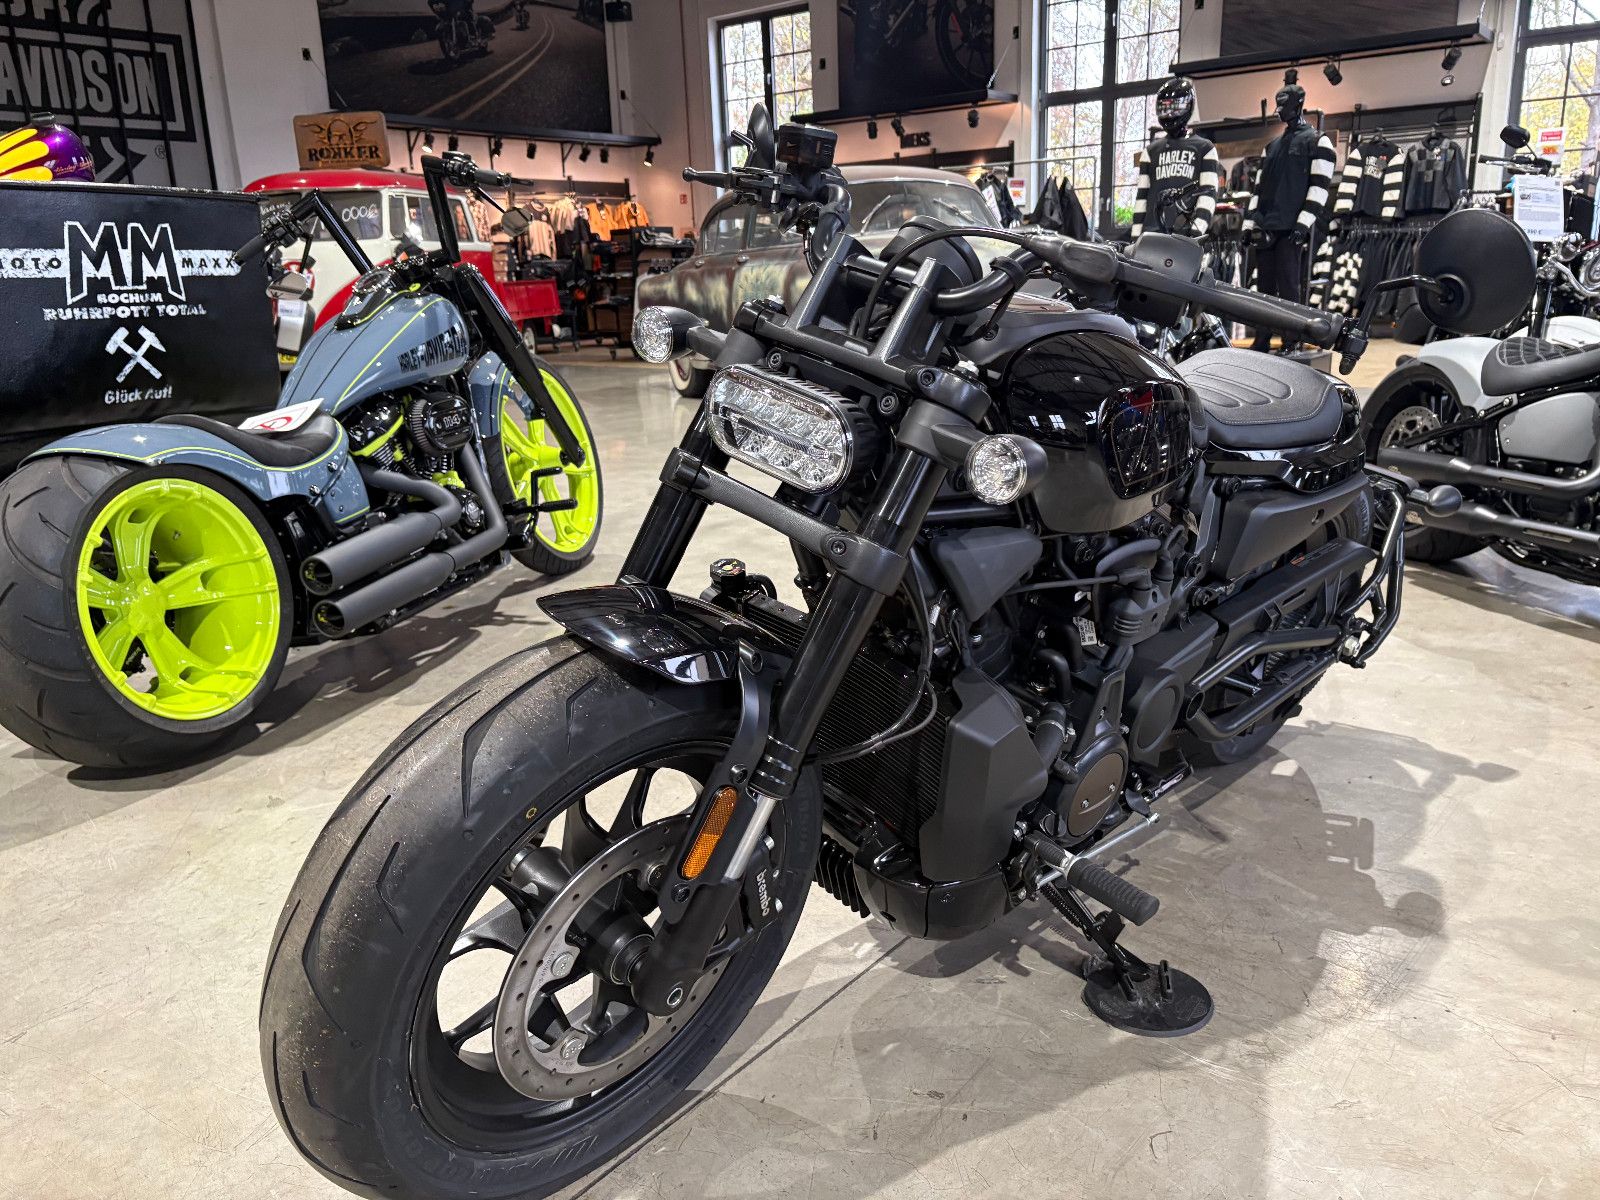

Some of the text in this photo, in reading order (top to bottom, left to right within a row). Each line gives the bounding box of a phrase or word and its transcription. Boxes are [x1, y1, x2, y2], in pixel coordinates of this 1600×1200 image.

[307, 145, 381, 161] ROKKER
[0, 257, 62, 270] OTO
[181, 256, 234, 269] MAXX
[97, 292, 164, 304] BOCHUM
[42, 304, 207, 321] RUHRPOTT TOTAL
[104, 387, 142, 404] Glück
[756, 868, 771, 917] brembo
